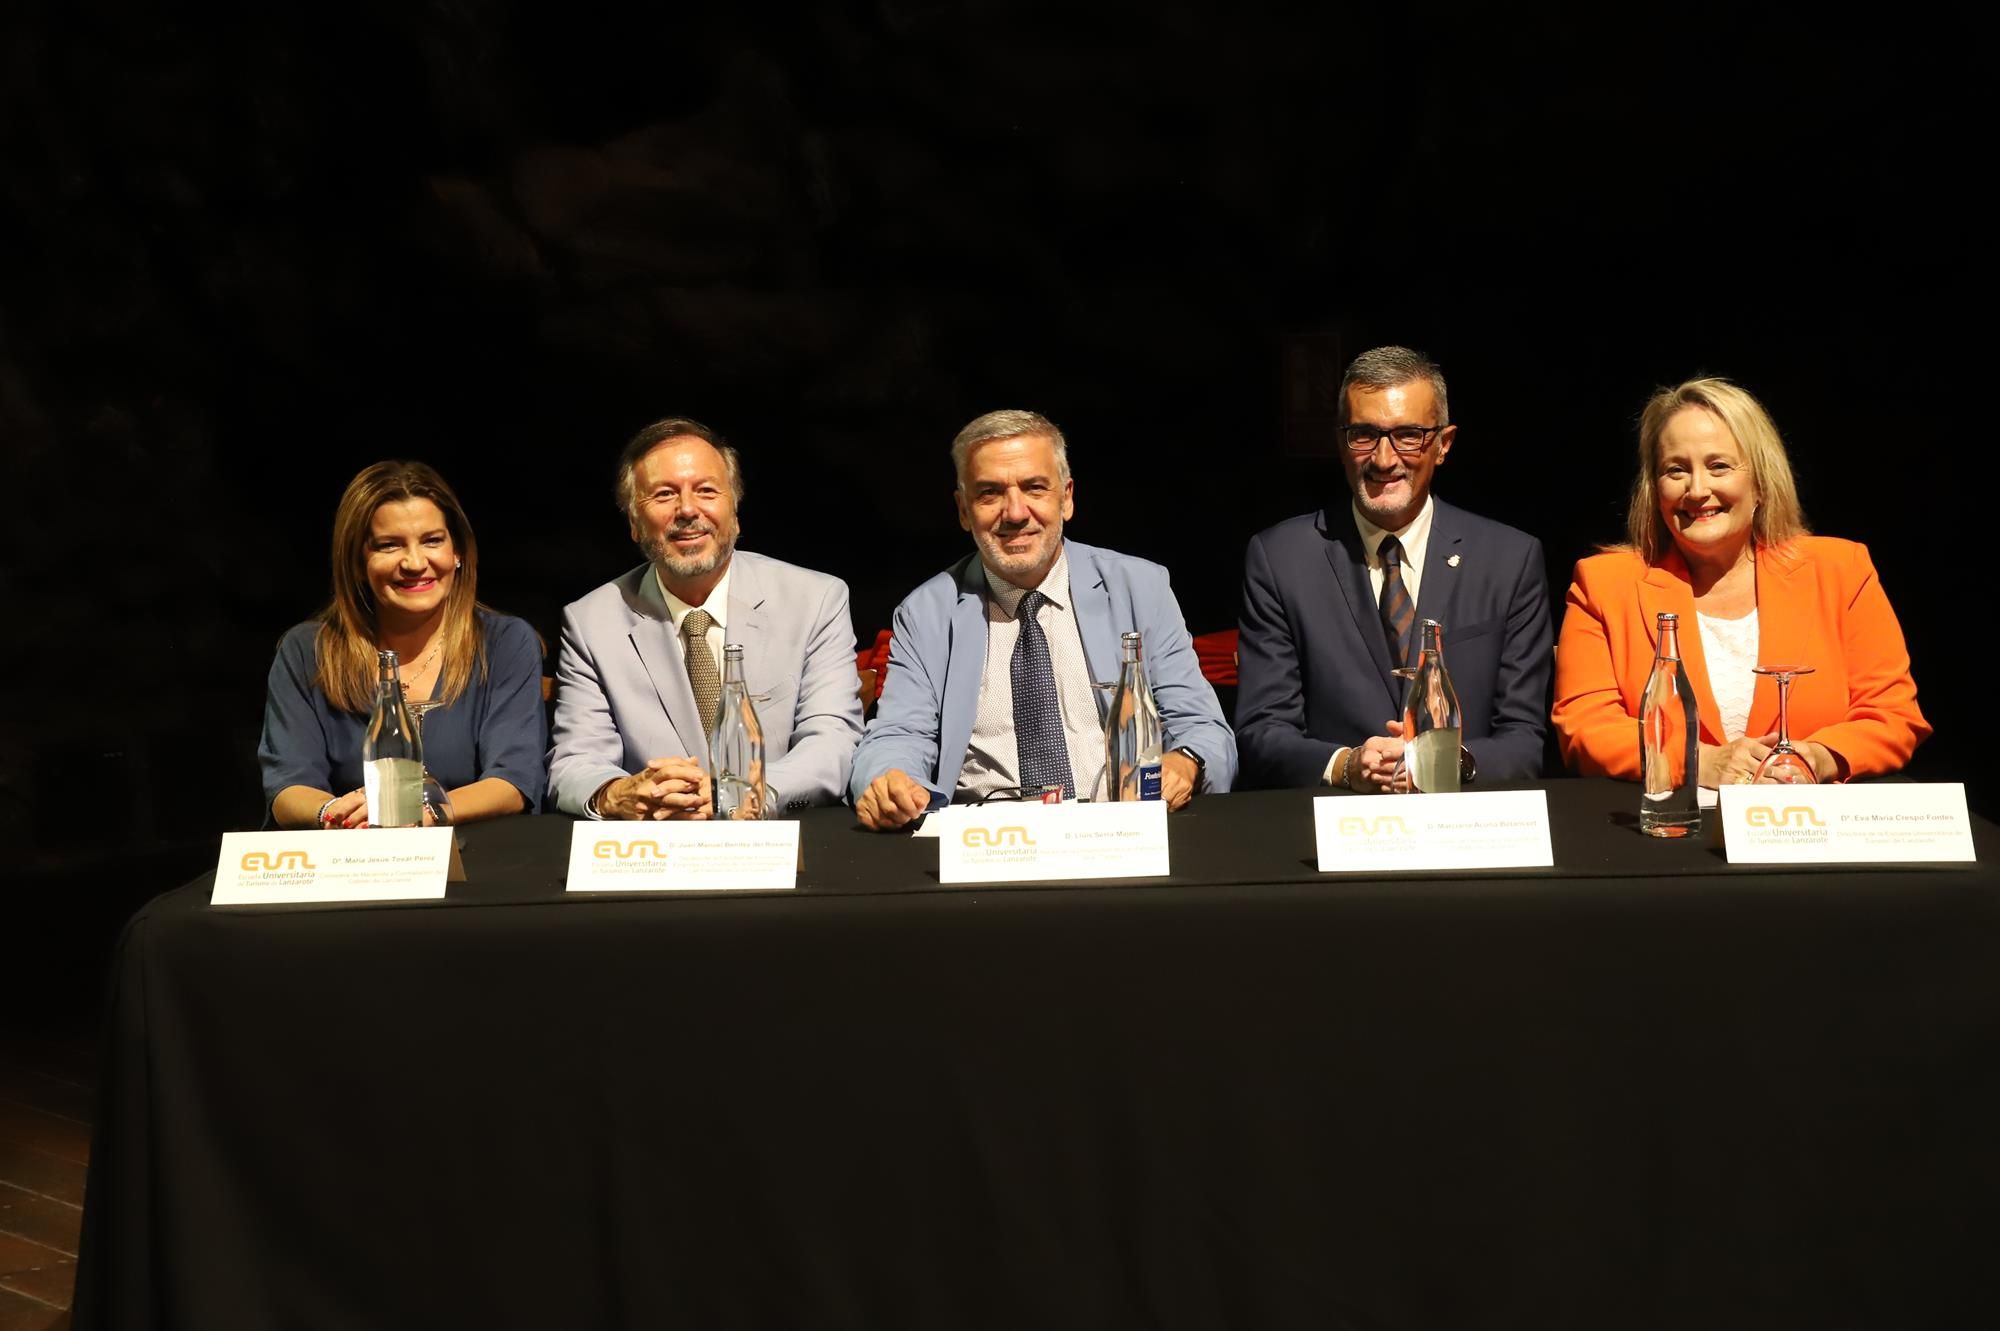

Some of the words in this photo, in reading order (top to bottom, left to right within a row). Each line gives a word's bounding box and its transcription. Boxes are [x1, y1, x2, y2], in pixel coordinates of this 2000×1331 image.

[1854, 814, 1870, 822] Eva
[1895, 814, 1925, 823] Crespo
[1926, 813, 1954, 822] Fontes
[1772, 828, 1828, 837] Universitaria
[1791, 836, 1829, 844] Lanzarote
[985, 848, 1038, 856] Universitaria
[615, 860, 667, 868] Universitaria
[262, 870, 316, 880] Universitaria
[279, 878, 314, 886] Lanzarote
